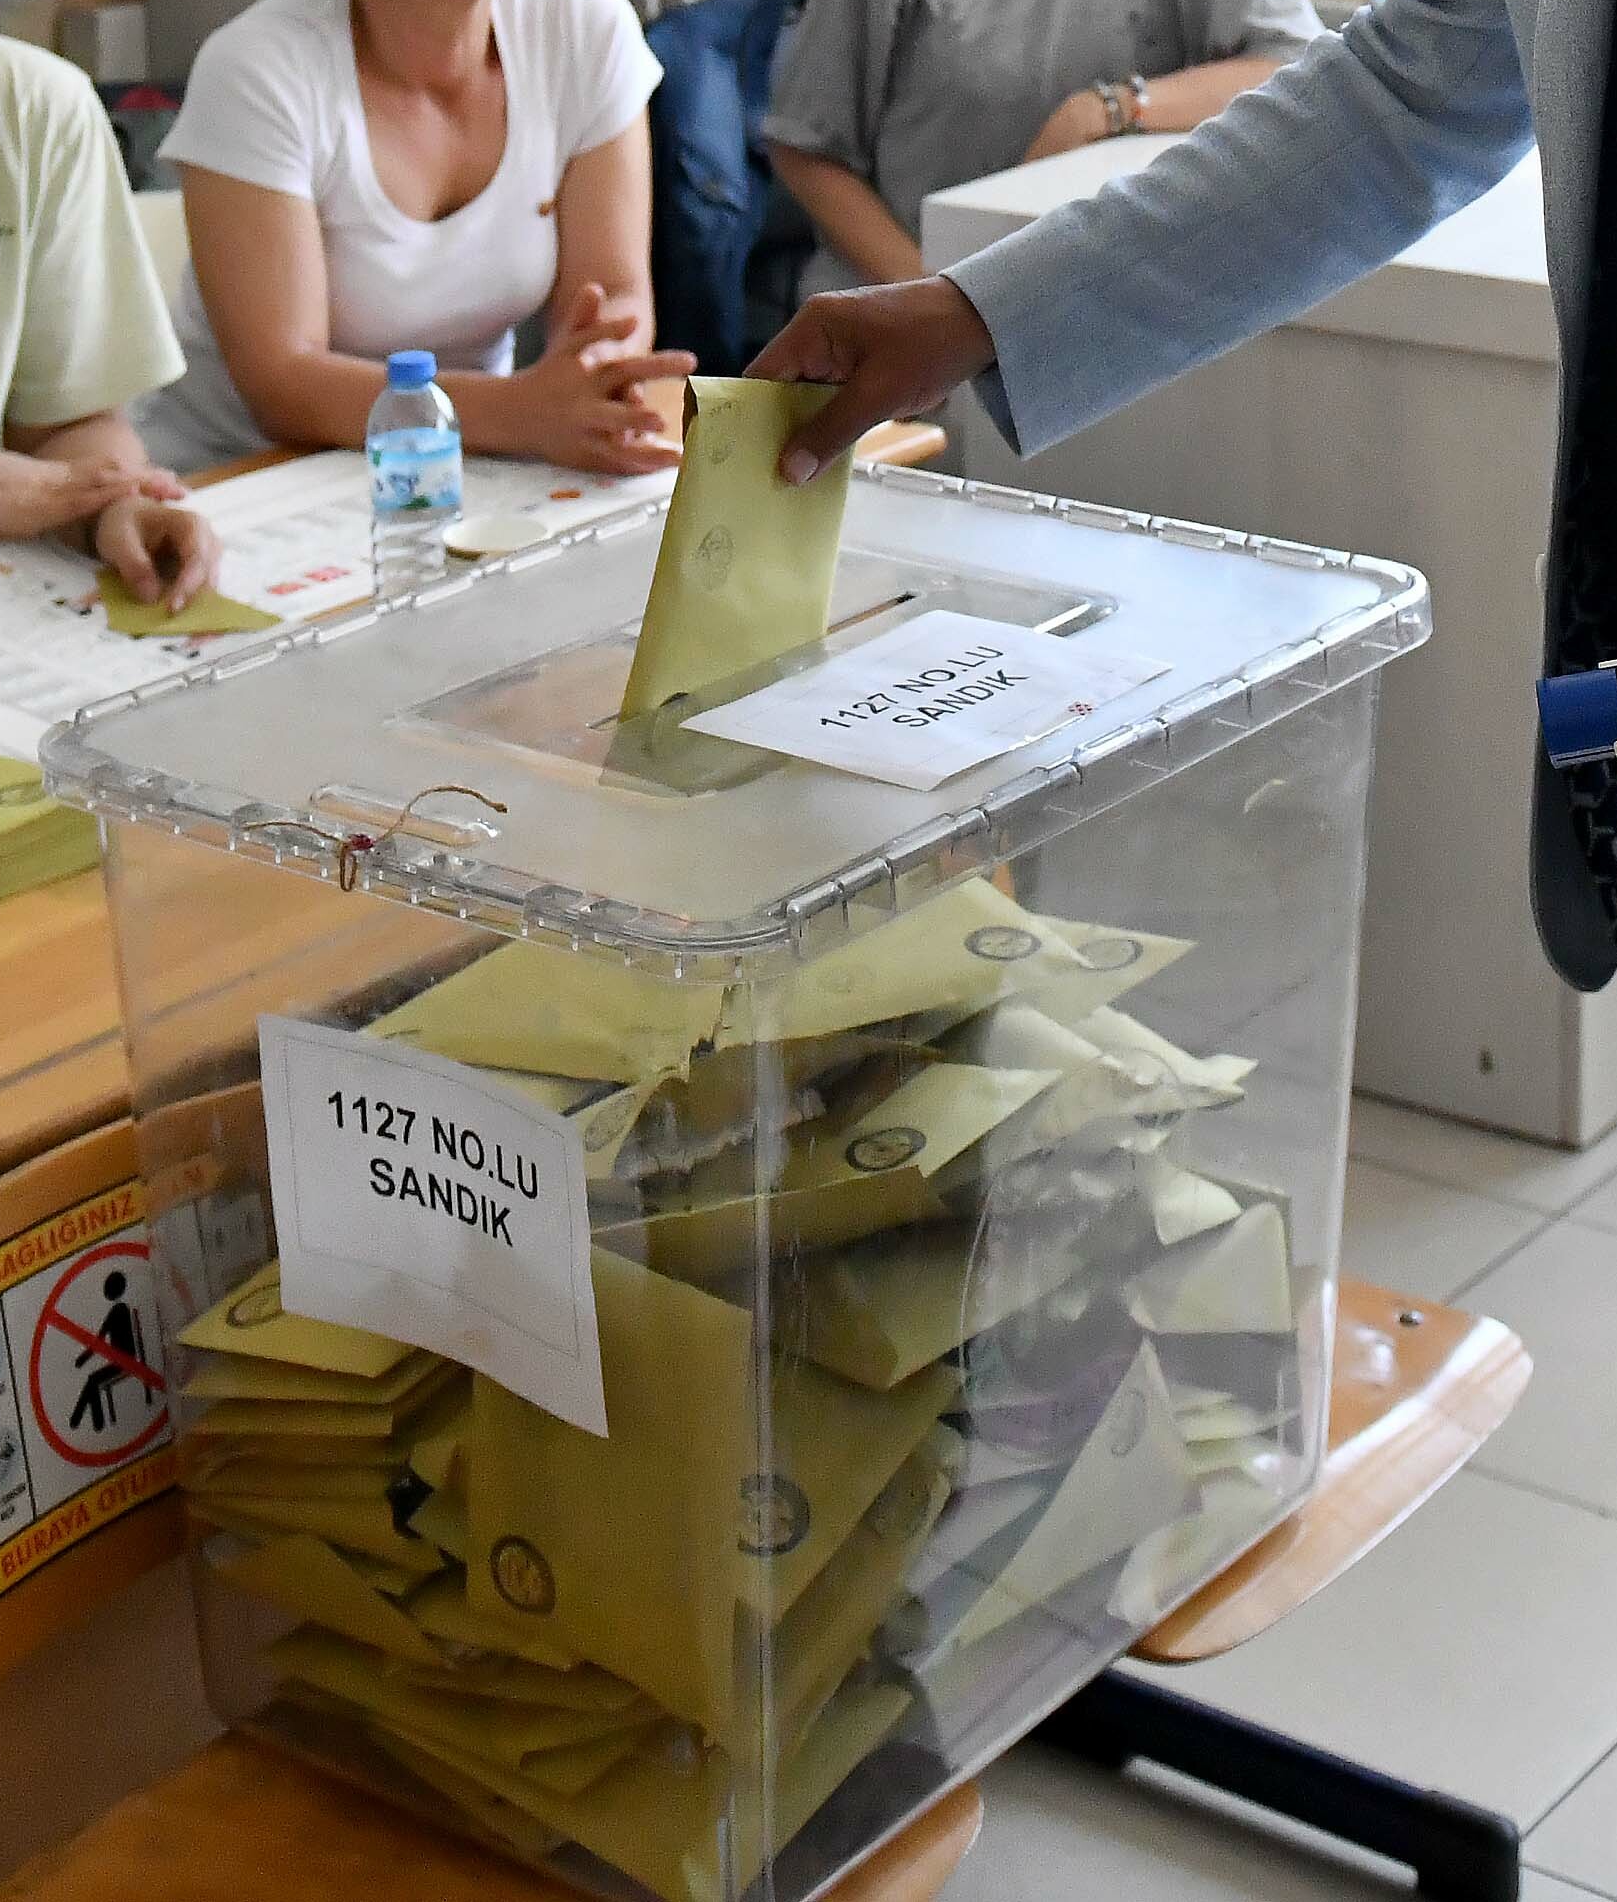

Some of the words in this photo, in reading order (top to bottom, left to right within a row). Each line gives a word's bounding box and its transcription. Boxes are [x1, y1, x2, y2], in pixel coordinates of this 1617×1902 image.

[820, 692, 899, 728] 1127
[892, 645, 1004, 694] NO.LU
[891, 669, 1030, 728] SANDIK
[328, 1091, 417, 1146] 1127
[431, 1116, 540, 1200] NO.LU
[369, 1158, 514, 1248] SANDIK
[0, 1500, 91, 1580] BURAYA
